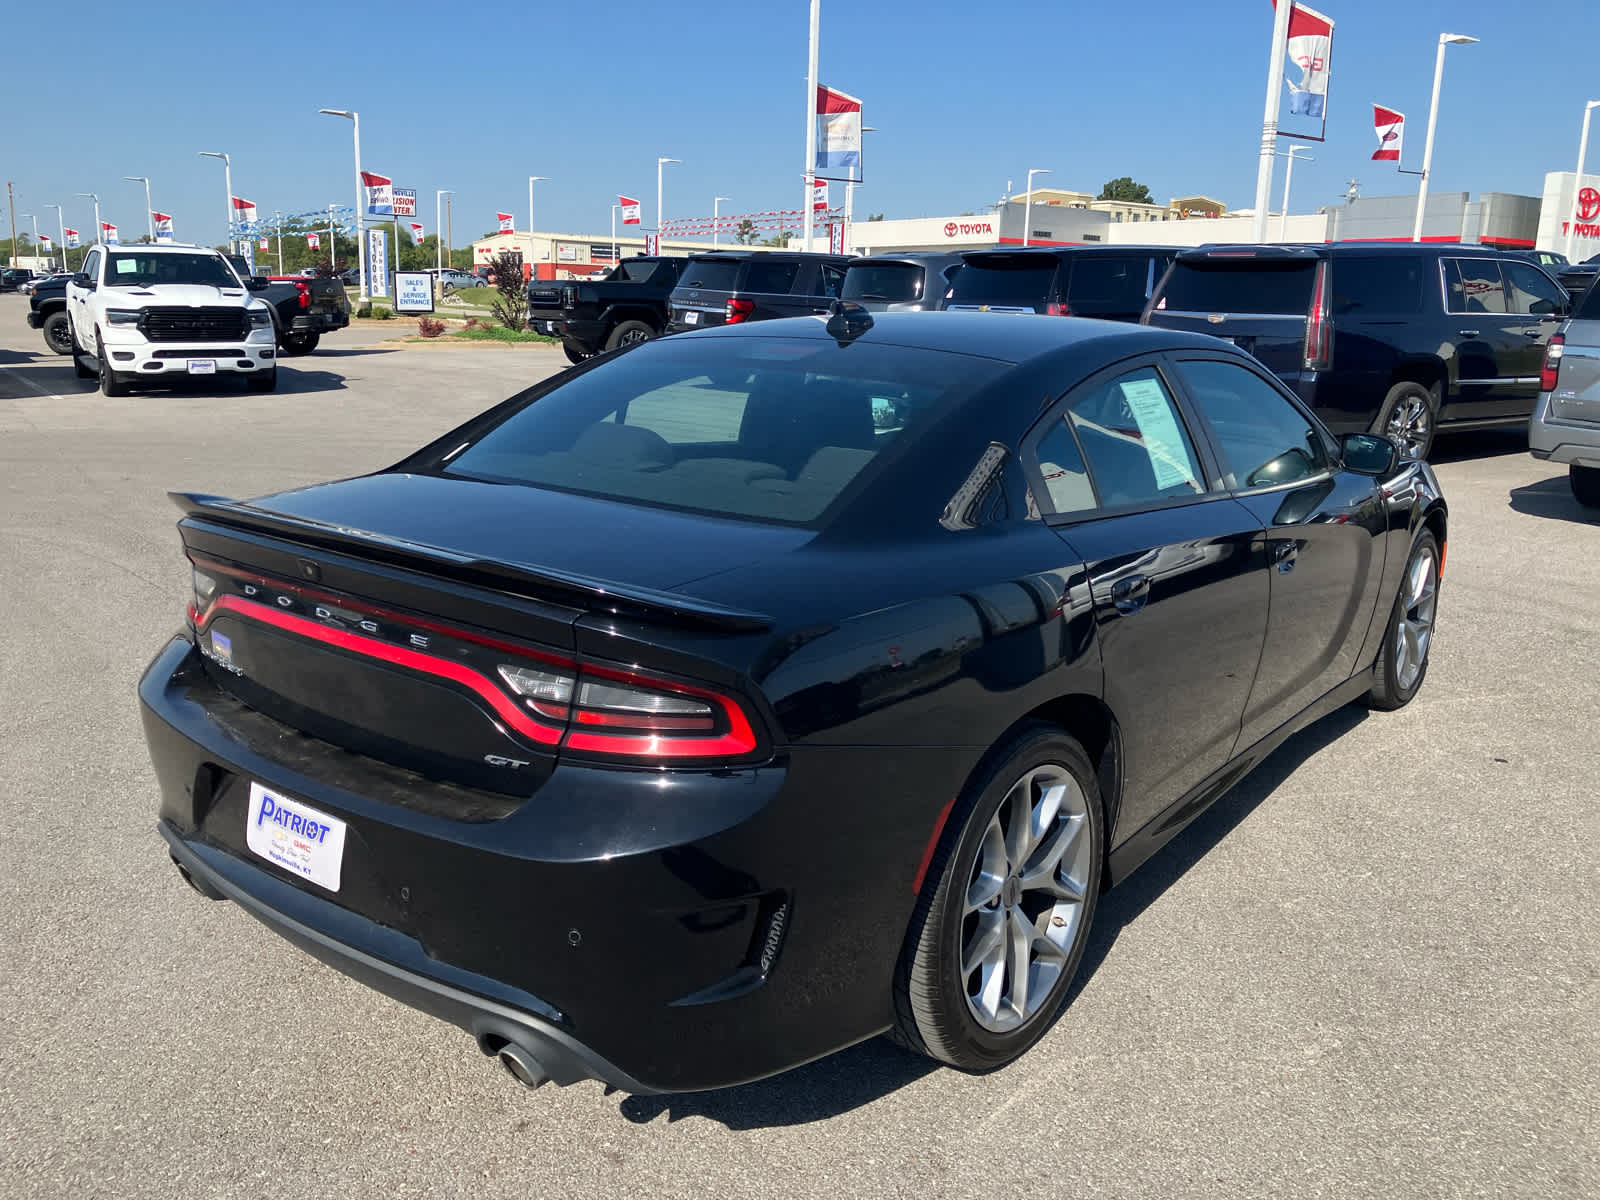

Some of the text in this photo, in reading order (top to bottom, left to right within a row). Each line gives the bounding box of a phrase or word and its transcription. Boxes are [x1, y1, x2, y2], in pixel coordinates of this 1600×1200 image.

[392, 197, 415, 206] LISION
[393, 206, 411, 215] NTER
[959, 223, 993, 235] TOYOTA
[1562, 221, 1600, 238] TYOTA
[244, 584, 429, 649] DODGE
[484, 754, 530, 768] GT
[257, 795, 331, 844] PATRIOT
[293, 839, 312, 853] GMC
[303, 864, 312, 876] KY
